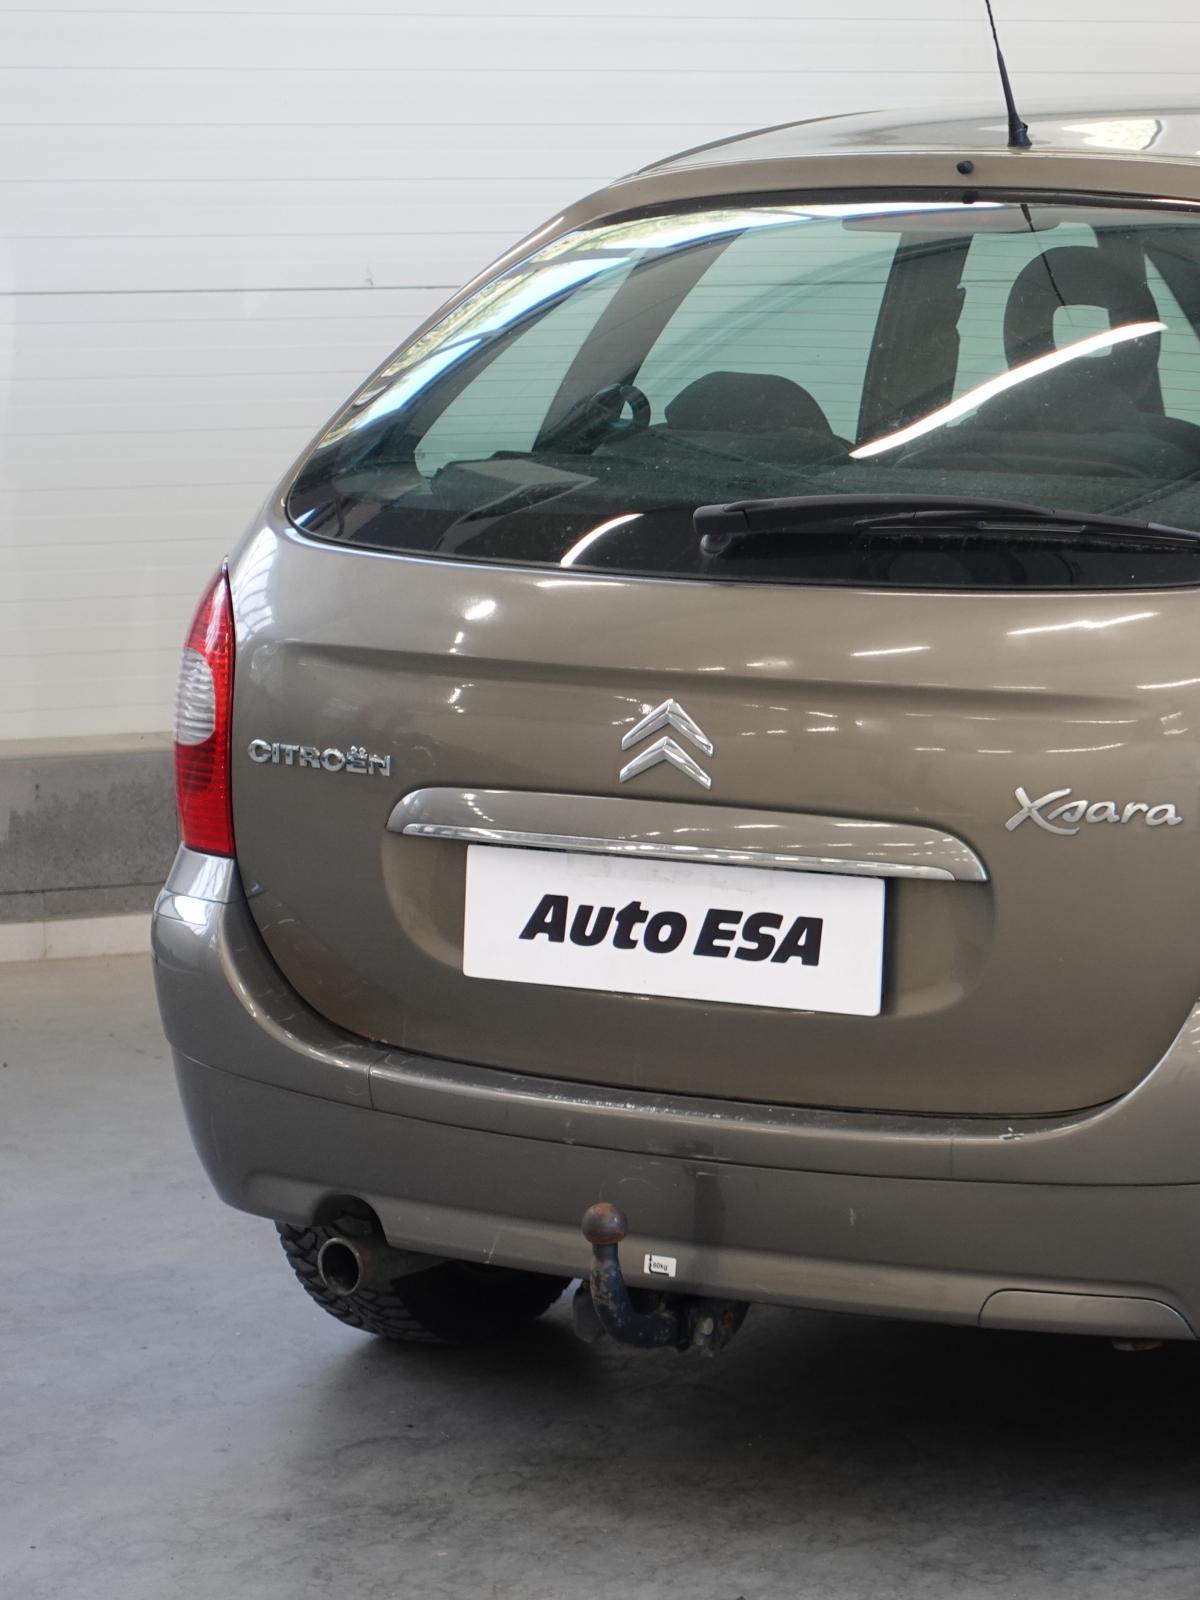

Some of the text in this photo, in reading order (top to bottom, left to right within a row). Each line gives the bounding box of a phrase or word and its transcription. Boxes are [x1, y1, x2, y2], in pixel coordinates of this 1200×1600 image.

[247, 738, 391, 777] CITROËN
[1004, 786, 1183, 836] Xsara
[518, 894, 824, 967] Auto ESA
